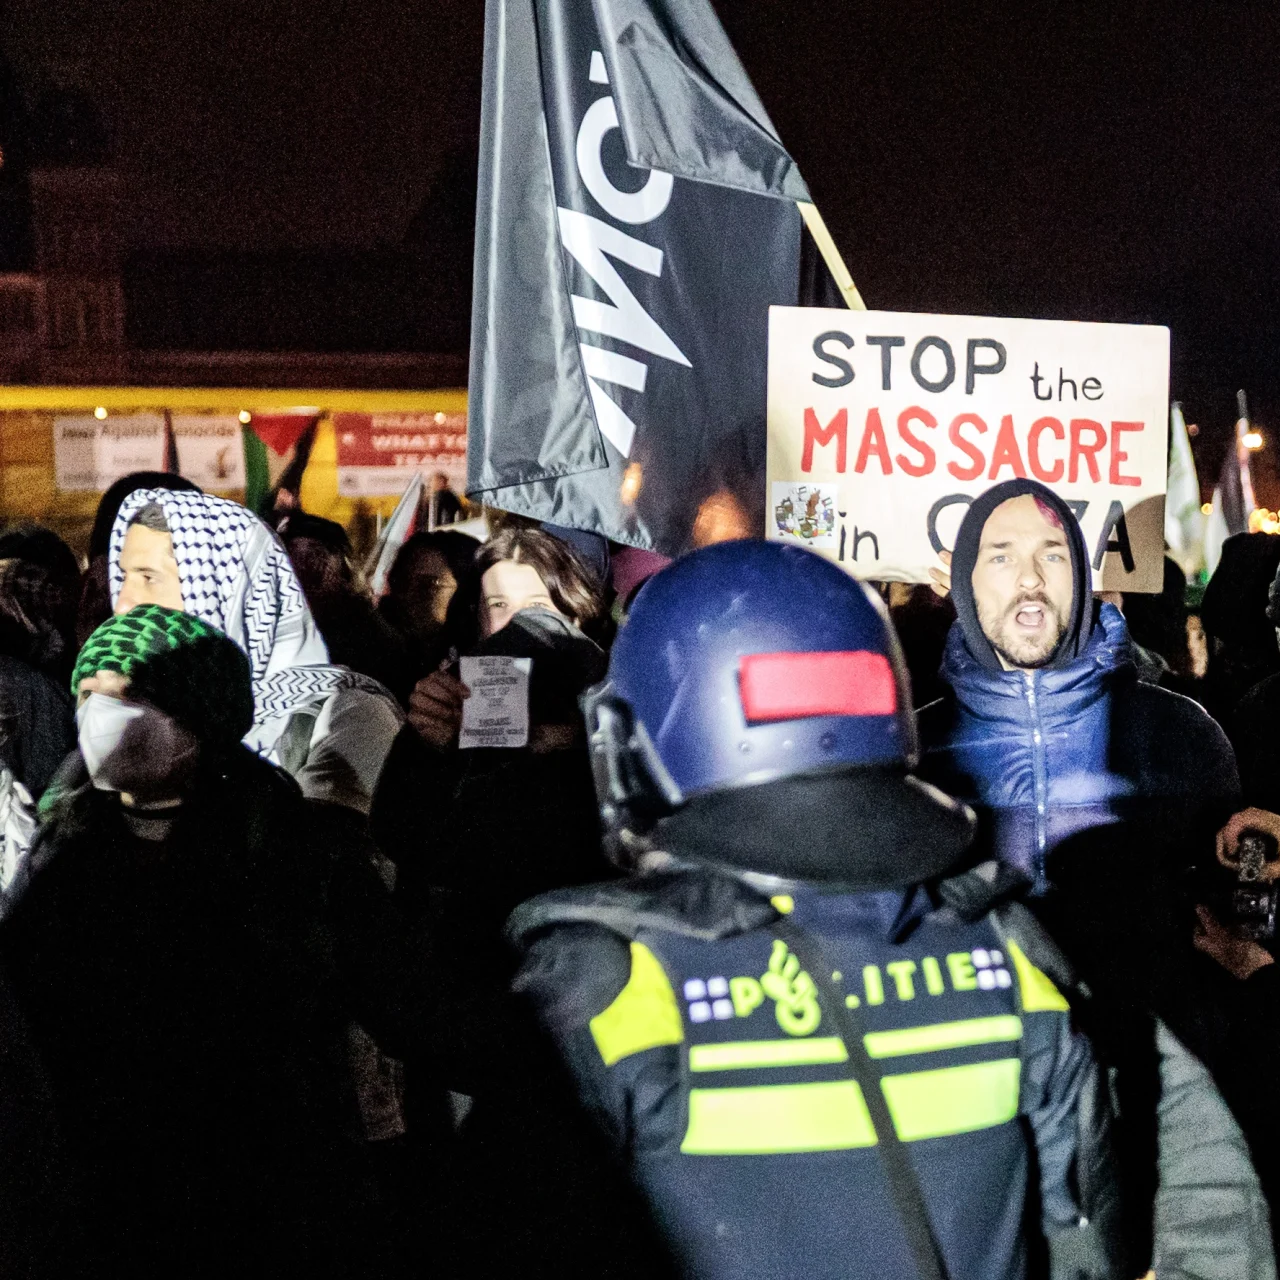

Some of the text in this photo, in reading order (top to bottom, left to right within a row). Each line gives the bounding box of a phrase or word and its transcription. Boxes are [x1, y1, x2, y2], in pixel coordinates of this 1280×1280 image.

[811, 330, 1104, 401] STOP the
[801, 406, 1145, 486] MASSACRE
[838, 511, 879, 562] in
